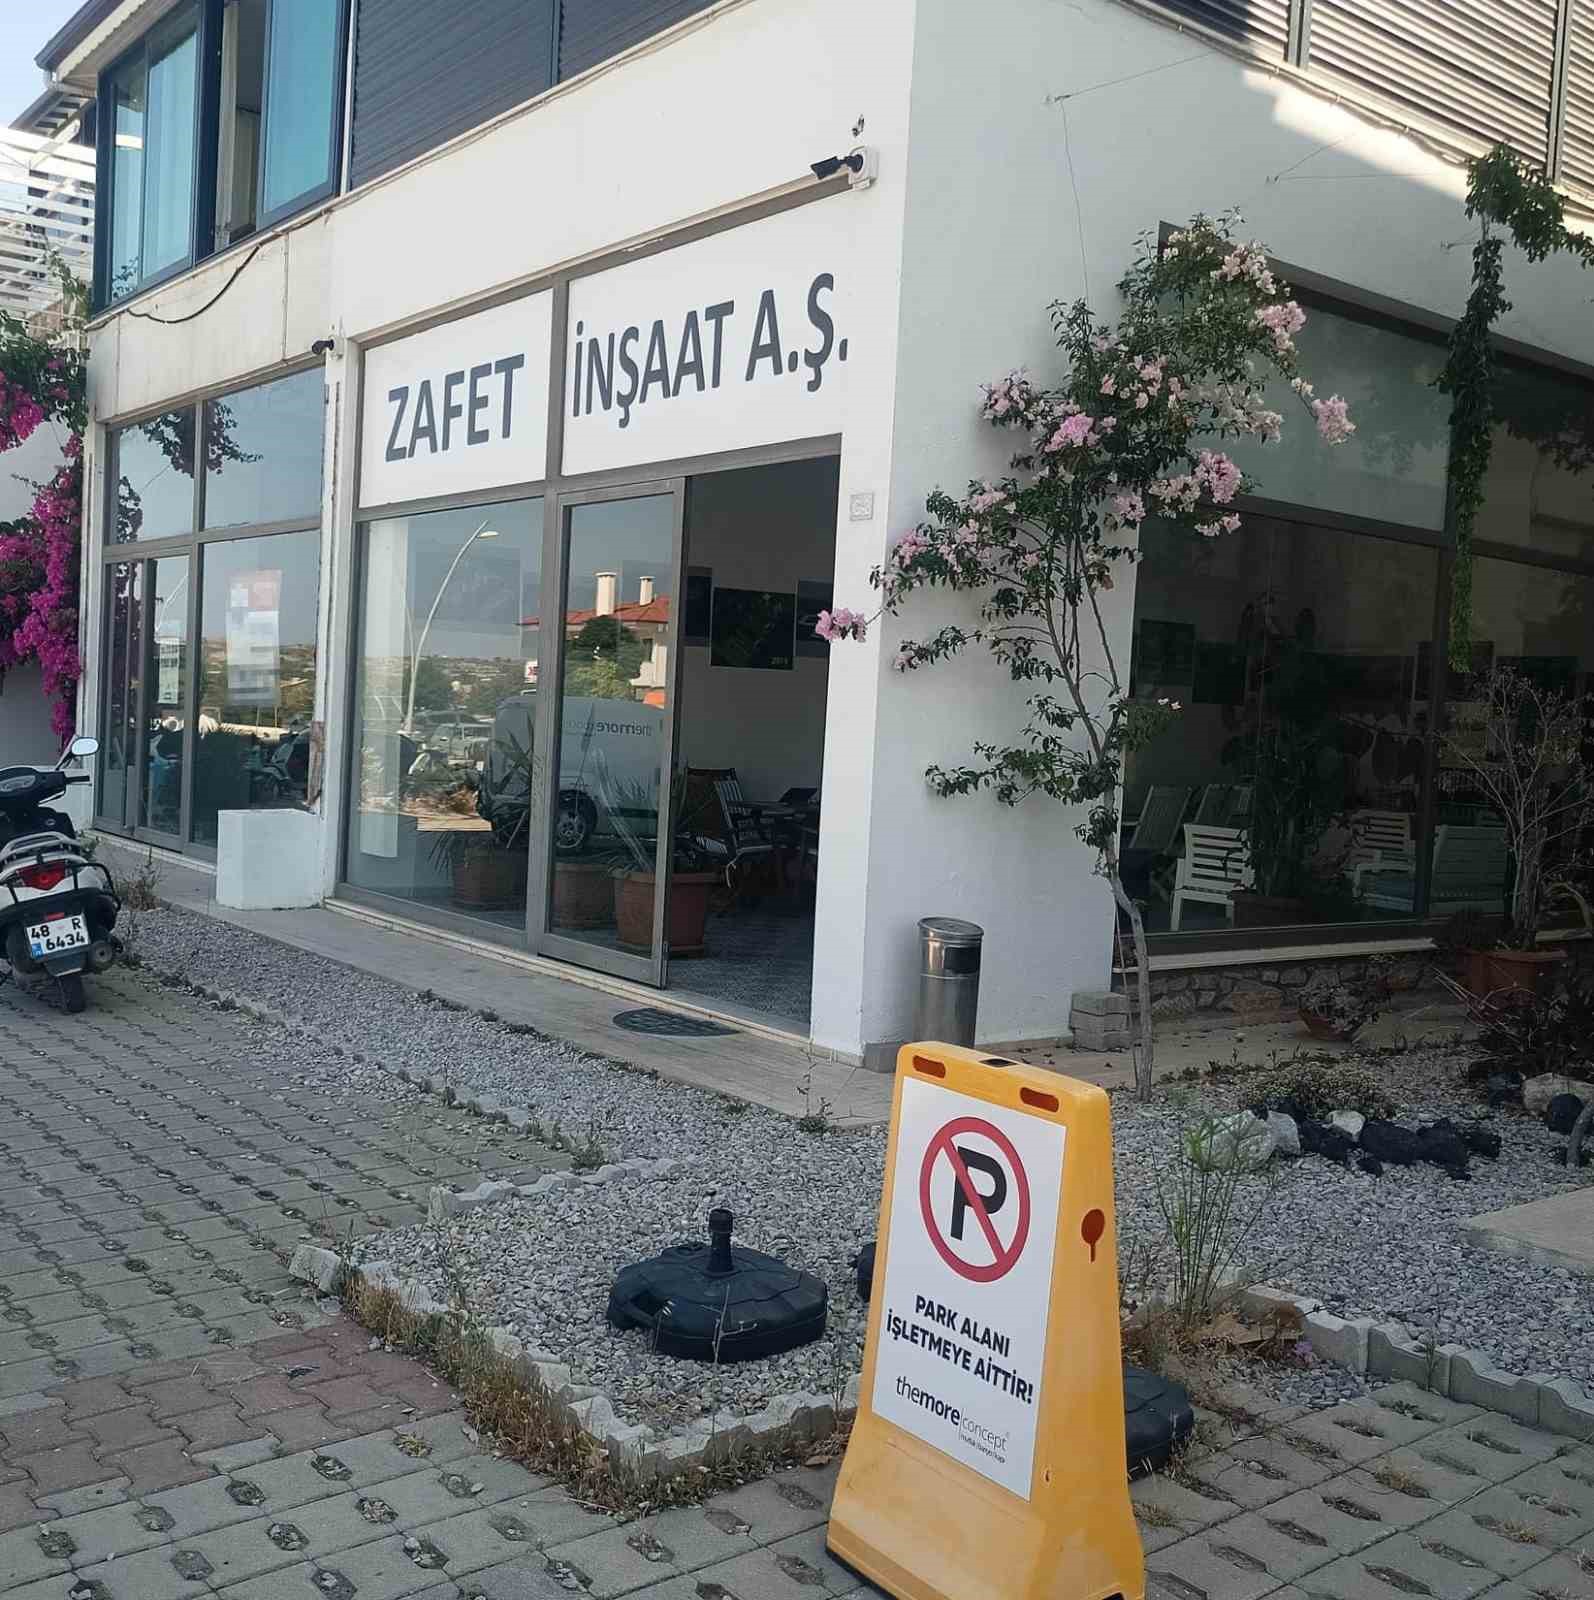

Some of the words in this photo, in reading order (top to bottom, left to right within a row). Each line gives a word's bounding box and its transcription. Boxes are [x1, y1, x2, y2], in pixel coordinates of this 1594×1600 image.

[385, 353, 525, 462] ZAFET
[573, 300, 735, 428] İNŞAAT
[745, 273, 848, 392] A.Ş.
[31, 925, 50, 939] 48
[71, 917, 82, 930] R
[46, 932, 85, 950] 6434
[950, 1146, 1007, 1240] P
[886, 1308, 971, 1371] İŞLETMEYE
[974, 1356, 1033, 1404] AİTTİR!
[915, 1295, 959, 1331] PARK
[960, 1317, 1010, 1357] ALANI
